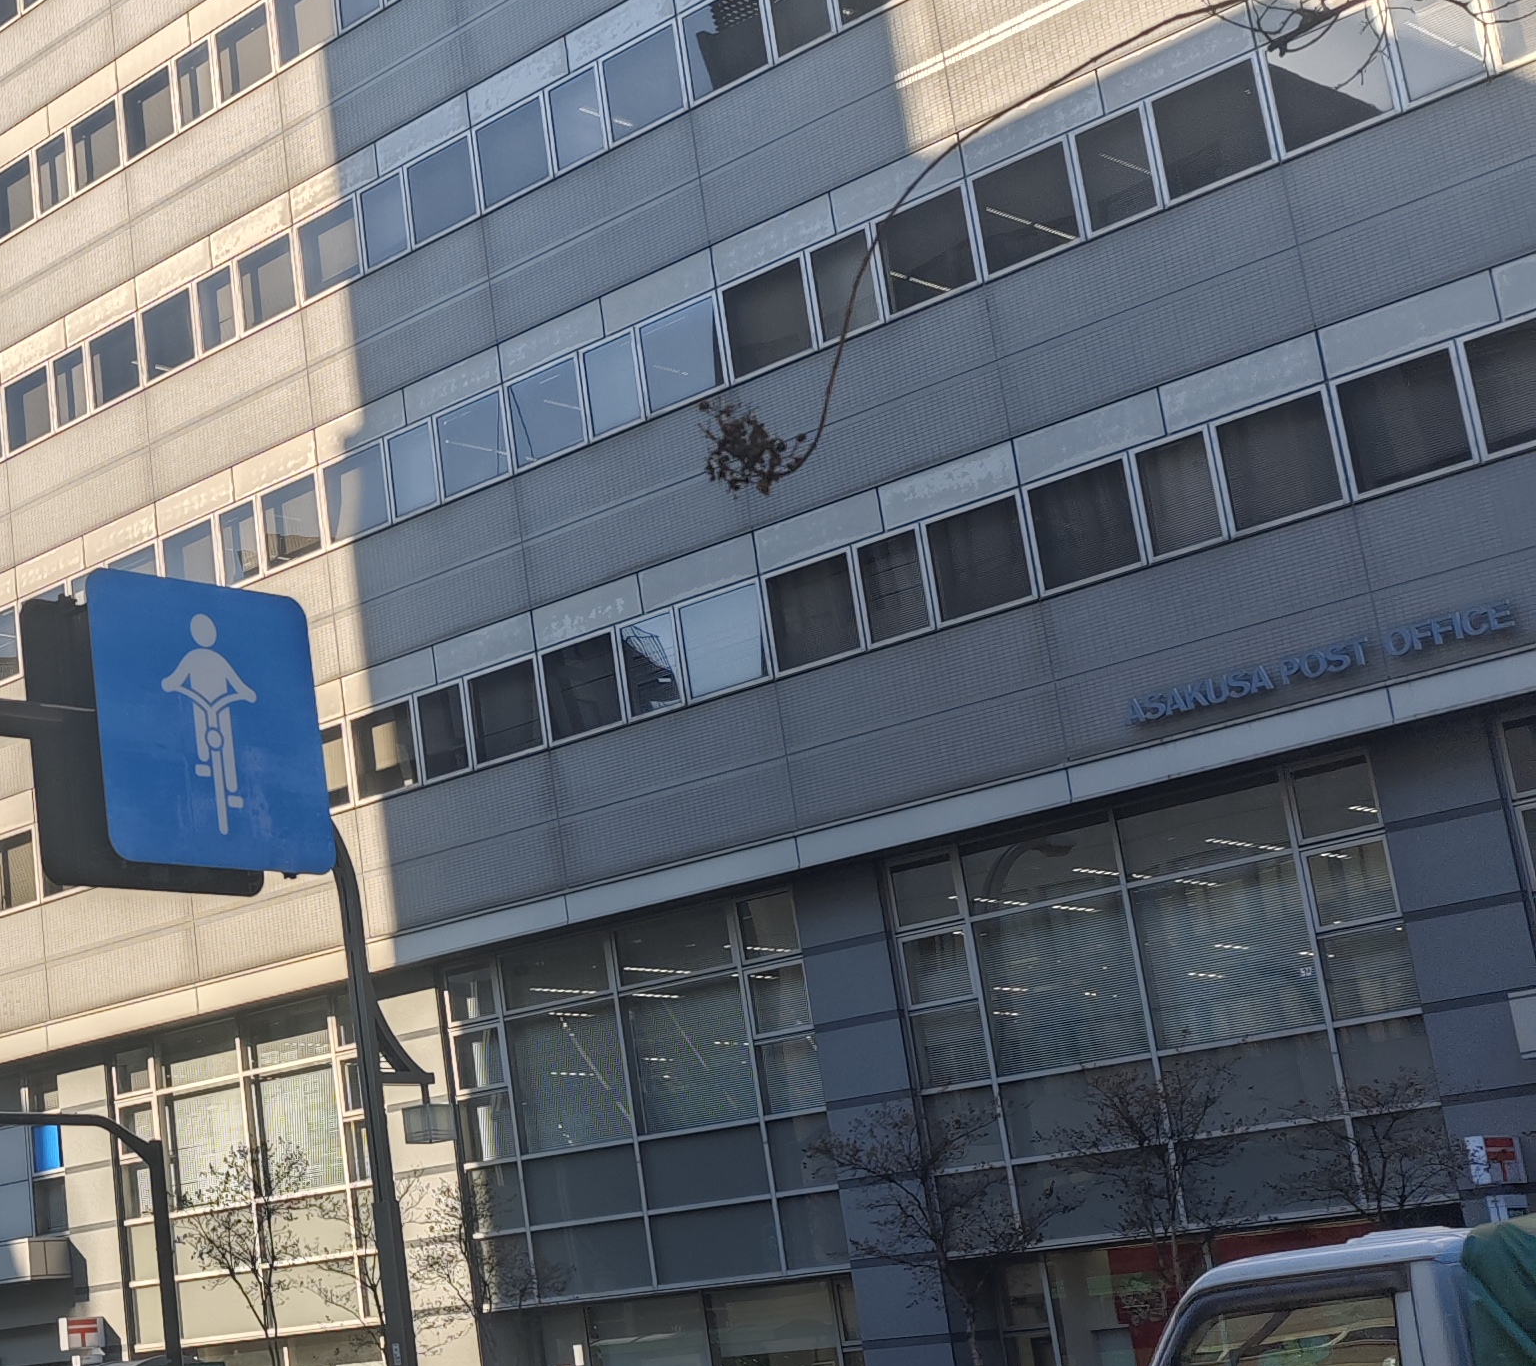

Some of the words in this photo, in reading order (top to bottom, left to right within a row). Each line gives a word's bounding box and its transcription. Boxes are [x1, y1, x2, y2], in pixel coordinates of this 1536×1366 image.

[1124, 664, 1274, 726] ASAKUSA
[1280, 637, 1368, 685] POST
[1384, 598, 1517, 657] OFFICE
